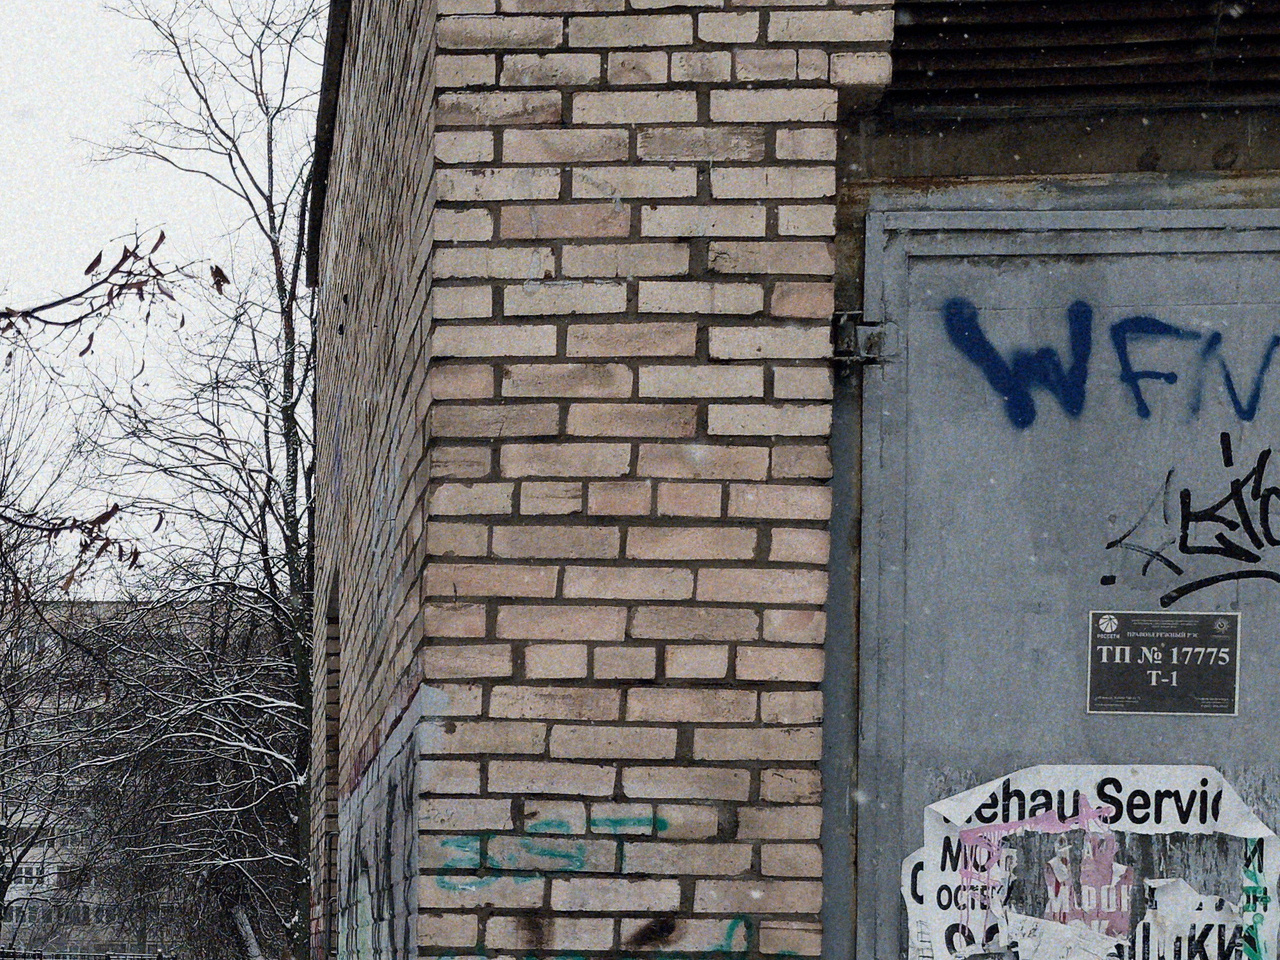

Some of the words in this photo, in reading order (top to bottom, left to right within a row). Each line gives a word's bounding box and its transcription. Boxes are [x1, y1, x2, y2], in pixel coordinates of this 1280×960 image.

[1096, 645, 1132, 664] ТП
[1136, 645, 1163, 665] №
[1169, 646, 1231, 666] 17775
[1146, 670, 1179, 687] Т-1
[942, 776, 1081, 825] ehau
